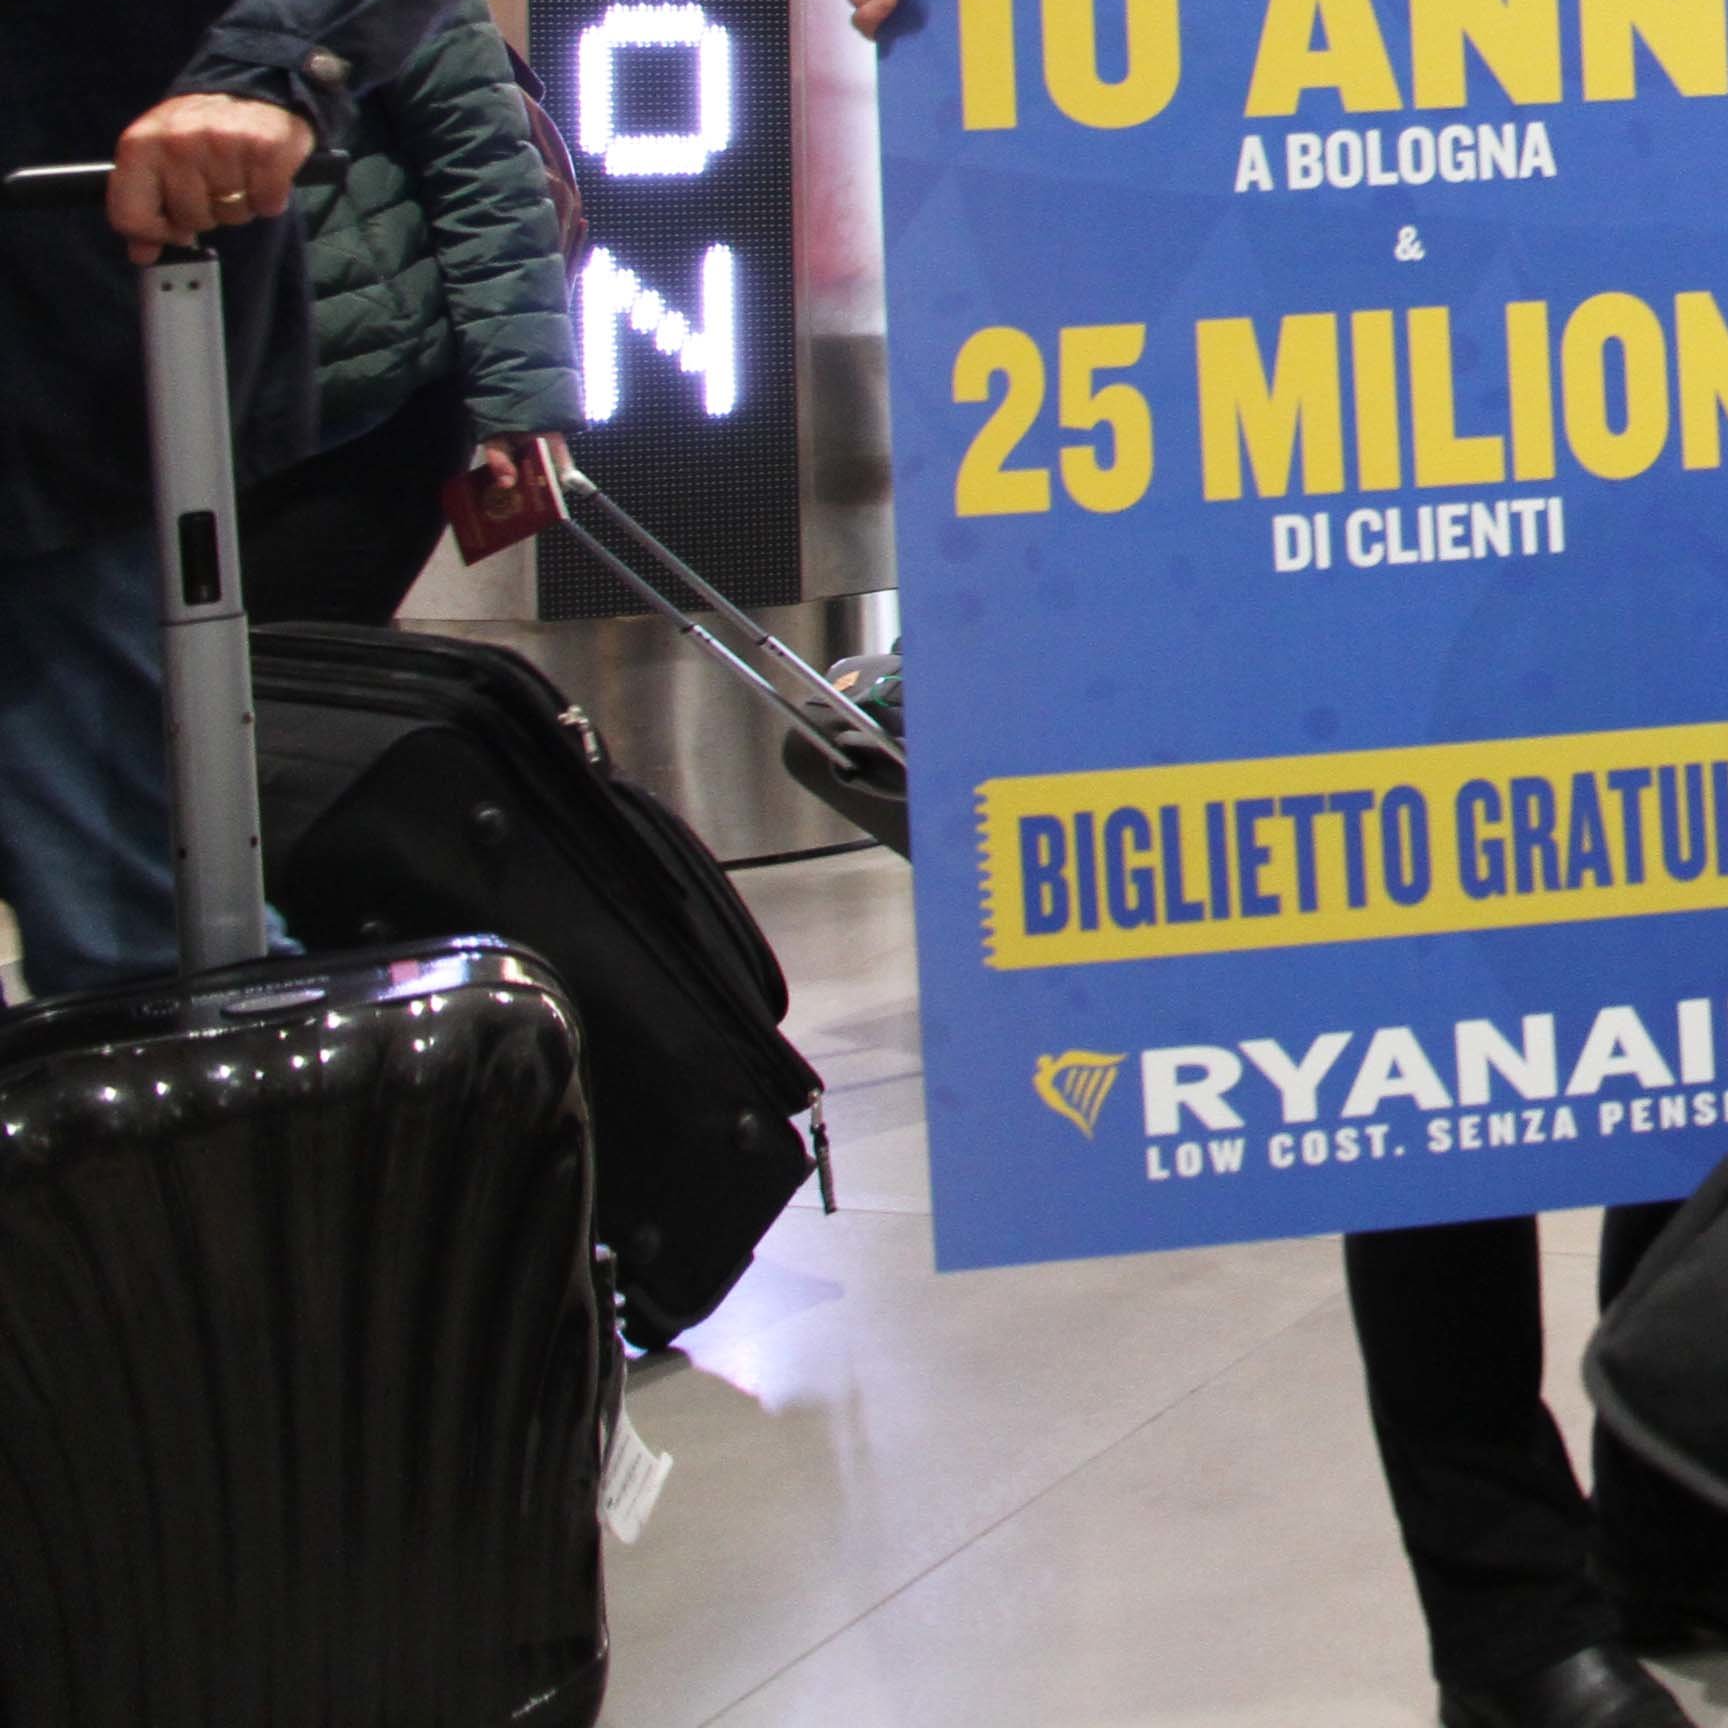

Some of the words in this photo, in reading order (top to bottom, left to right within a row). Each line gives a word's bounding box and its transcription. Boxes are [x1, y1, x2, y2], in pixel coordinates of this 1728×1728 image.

[1234, 134, 1274, 193] A
[1285, 121, 1558, 191] BOLOGNA
[1393, 225, 1426, 263] &
[953, 323, 1154, 517] 25
[1271, 512, 1332, 573] DI
[1345, 497, 1566, 568] CLIENTI
[1019, 784, 1432, 937] BIGLIETTO
[1146, 1138, 1245, 1181] LOW
[1267, 1124, 1404, 1169] COST.
[1427, 1106, 1578, 1154] SENZA
